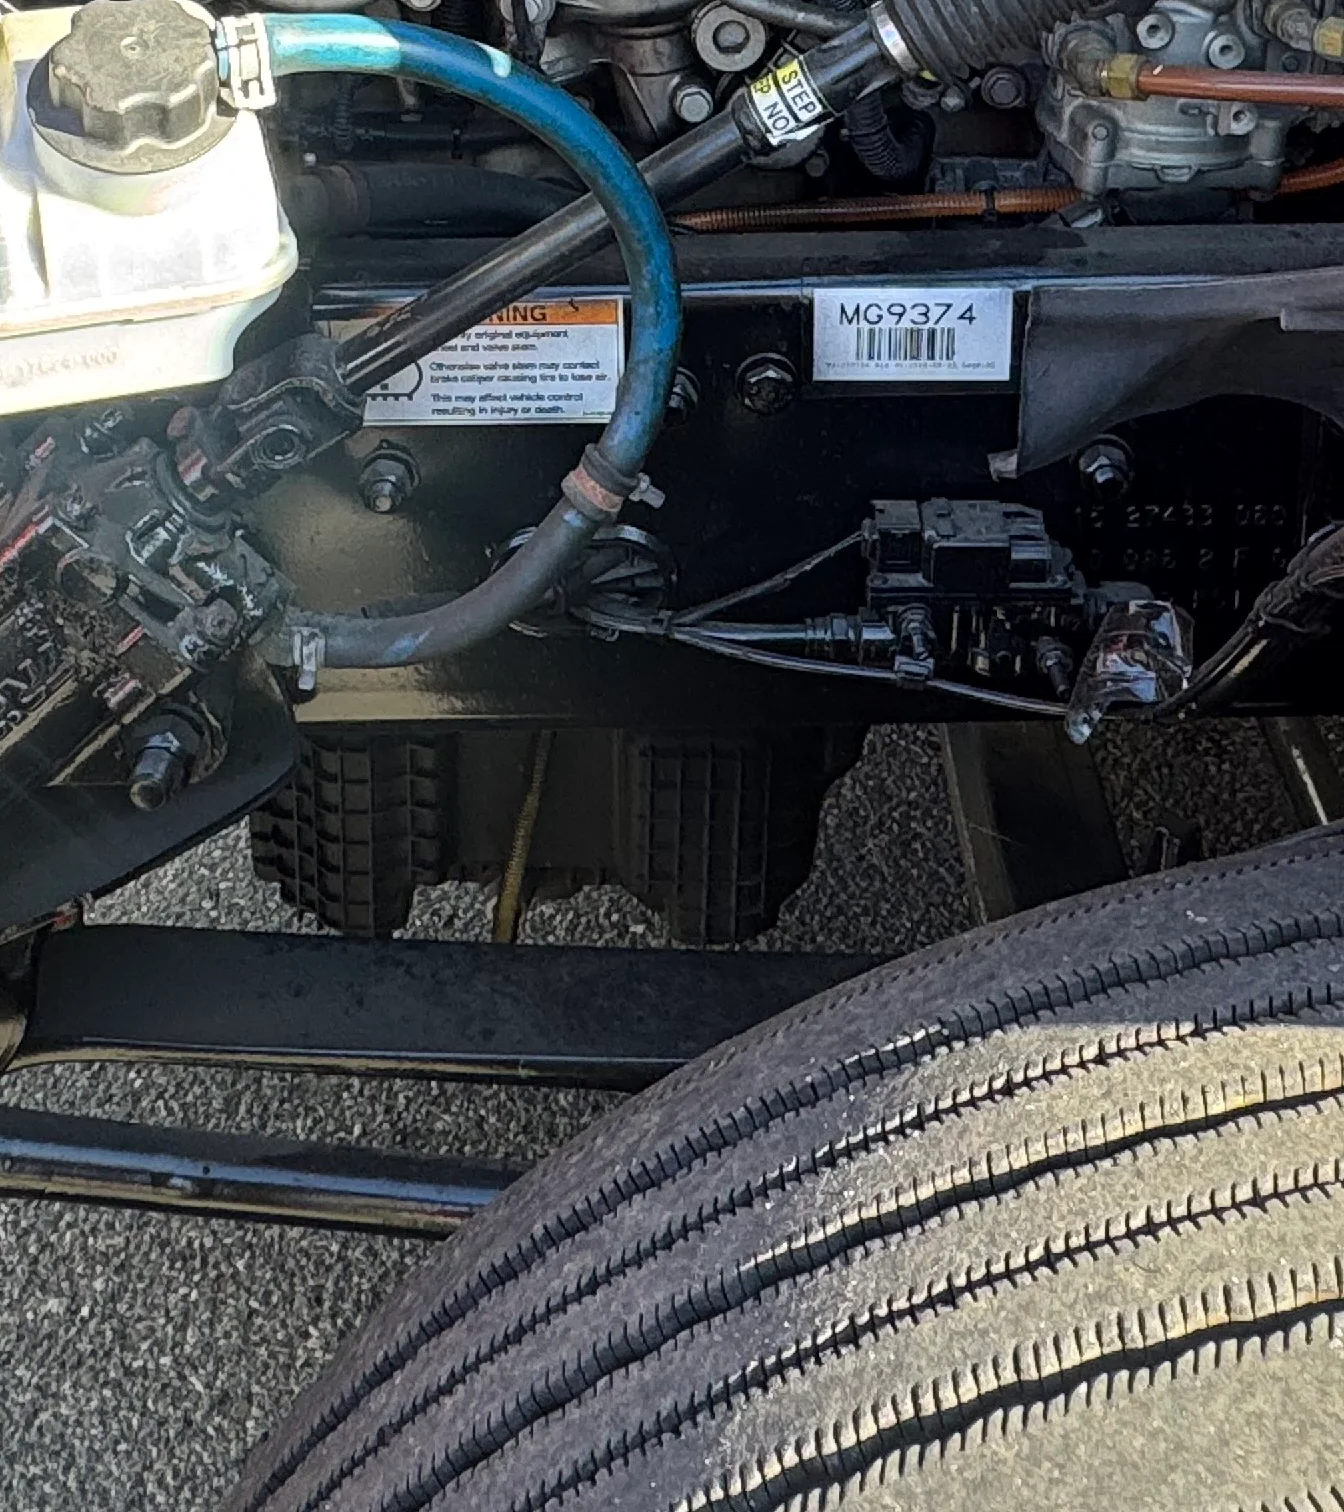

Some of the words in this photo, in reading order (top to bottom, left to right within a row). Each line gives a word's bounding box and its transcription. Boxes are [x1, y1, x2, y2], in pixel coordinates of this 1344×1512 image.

[781, 70, 816, 113] STEP
[763, 101, 790, 131] NO
[838, 302, 977, 326] MG9374
[460, 343, 480, 352] and
[558, 373, 569, 382] to
[430, 393, 453, 403] This
[546, 392, 584, 402] control
[431, 406, 476, 417] resulting
[478, 406, 488, 415] in
[490, 406, 519, 417] injury
[520, 407, 532, 415] or
[534, 405, 565, 415] death.
